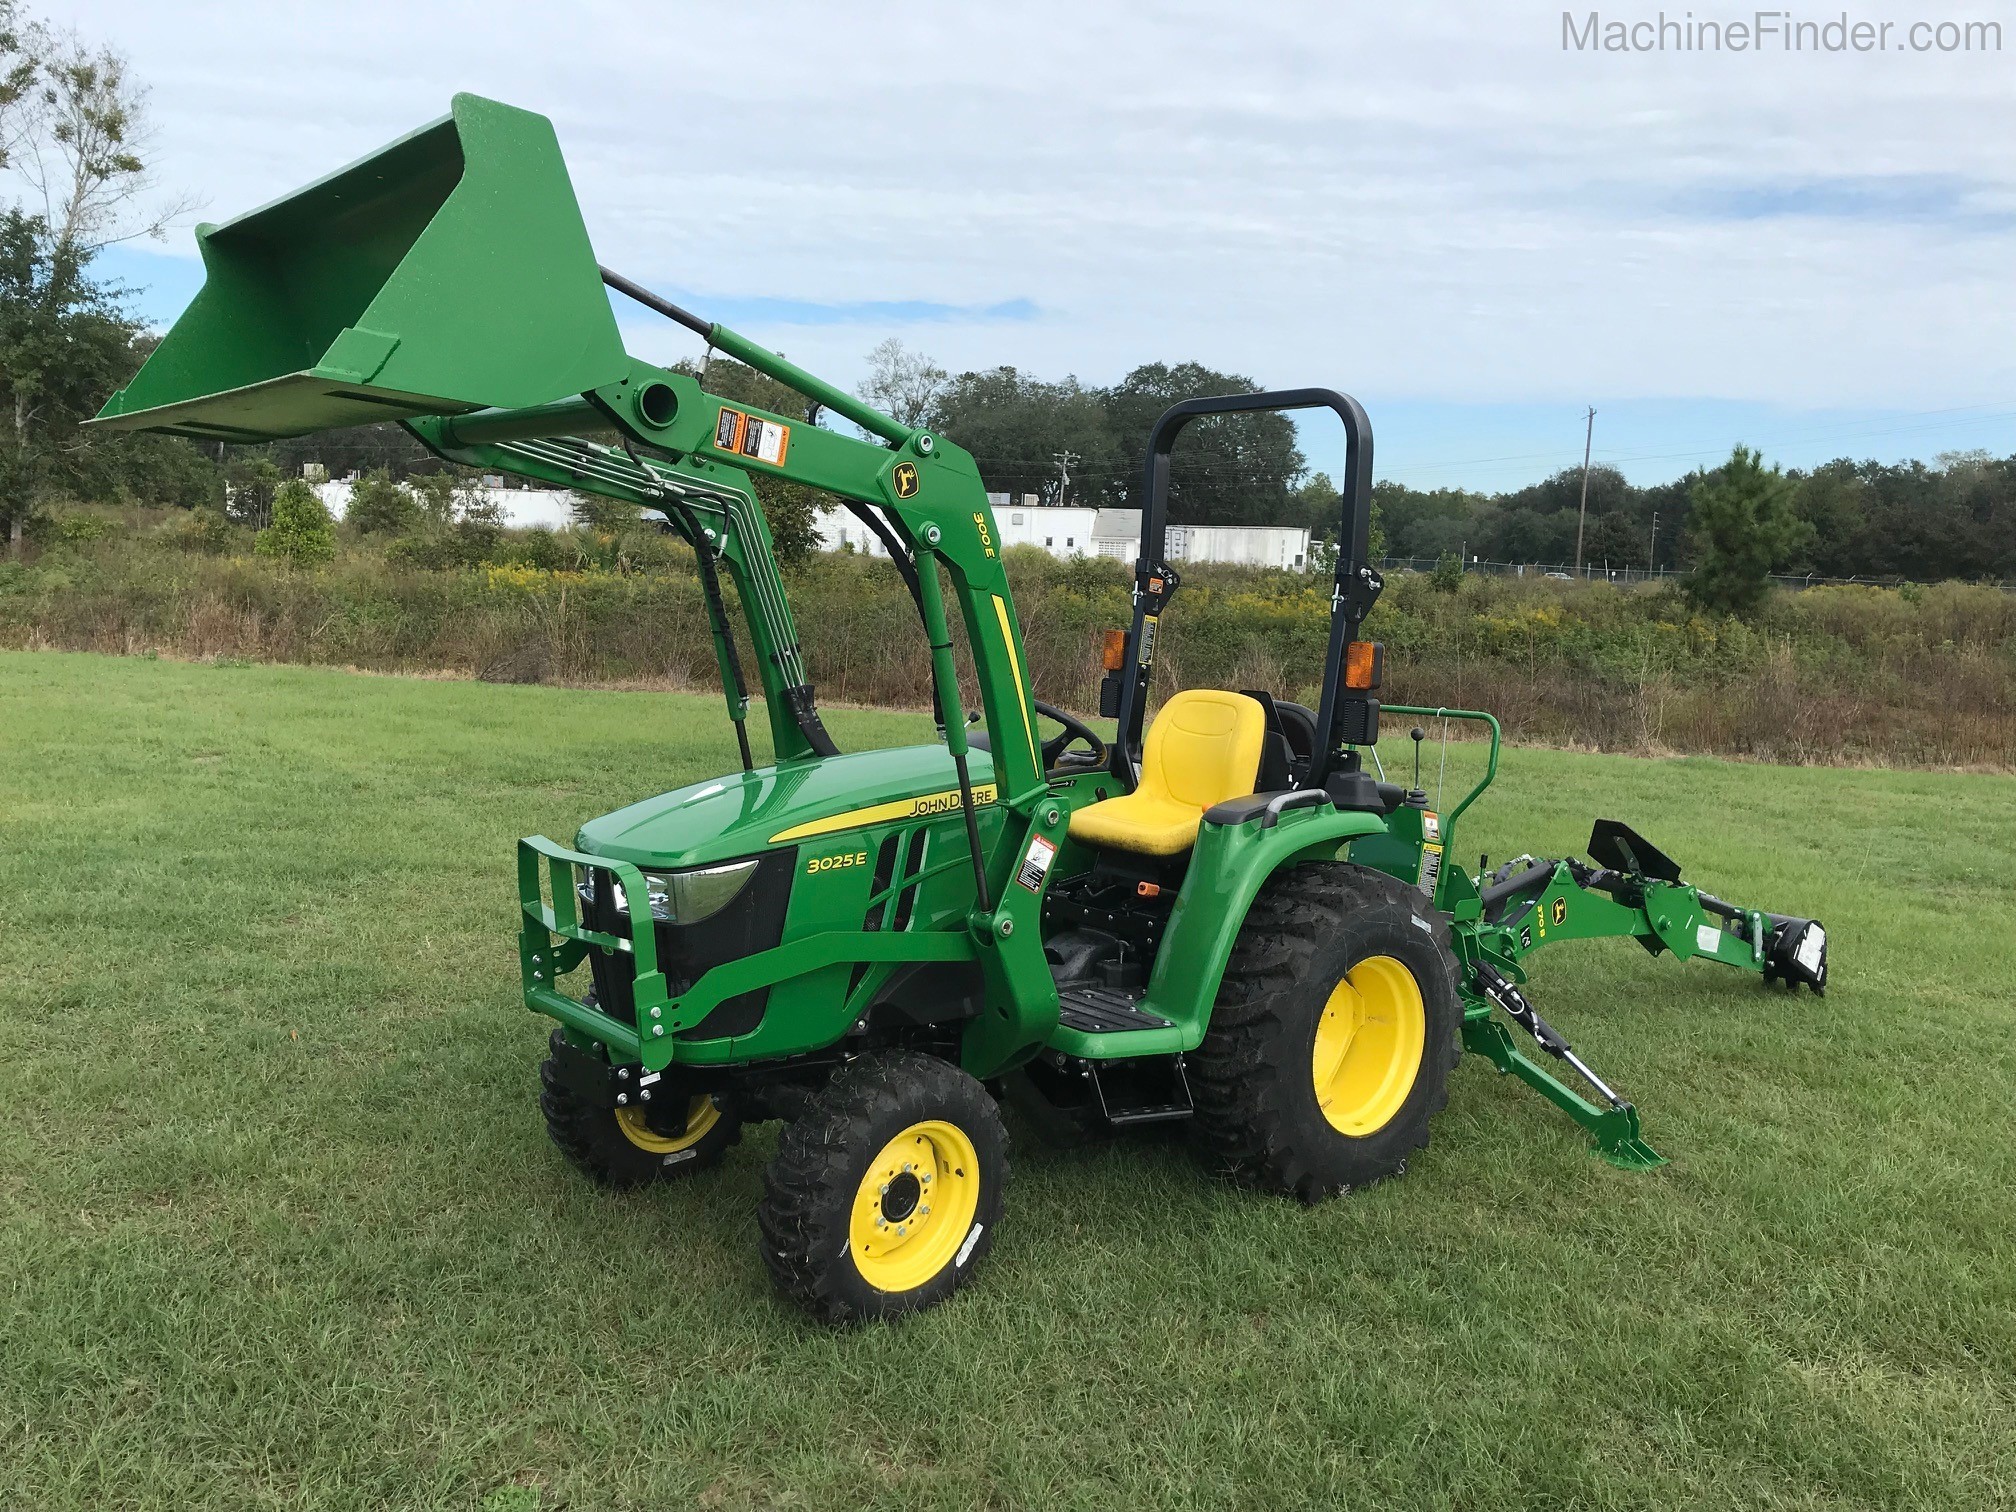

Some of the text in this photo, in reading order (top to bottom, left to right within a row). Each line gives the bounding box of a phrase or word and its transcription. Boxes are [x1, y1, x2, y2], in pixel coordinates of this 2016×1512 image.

[973, 512, 995, 558] 300E
[910, 789, 992, 816] JOHN DERE
[807, 851, 868, 874] 3025E
